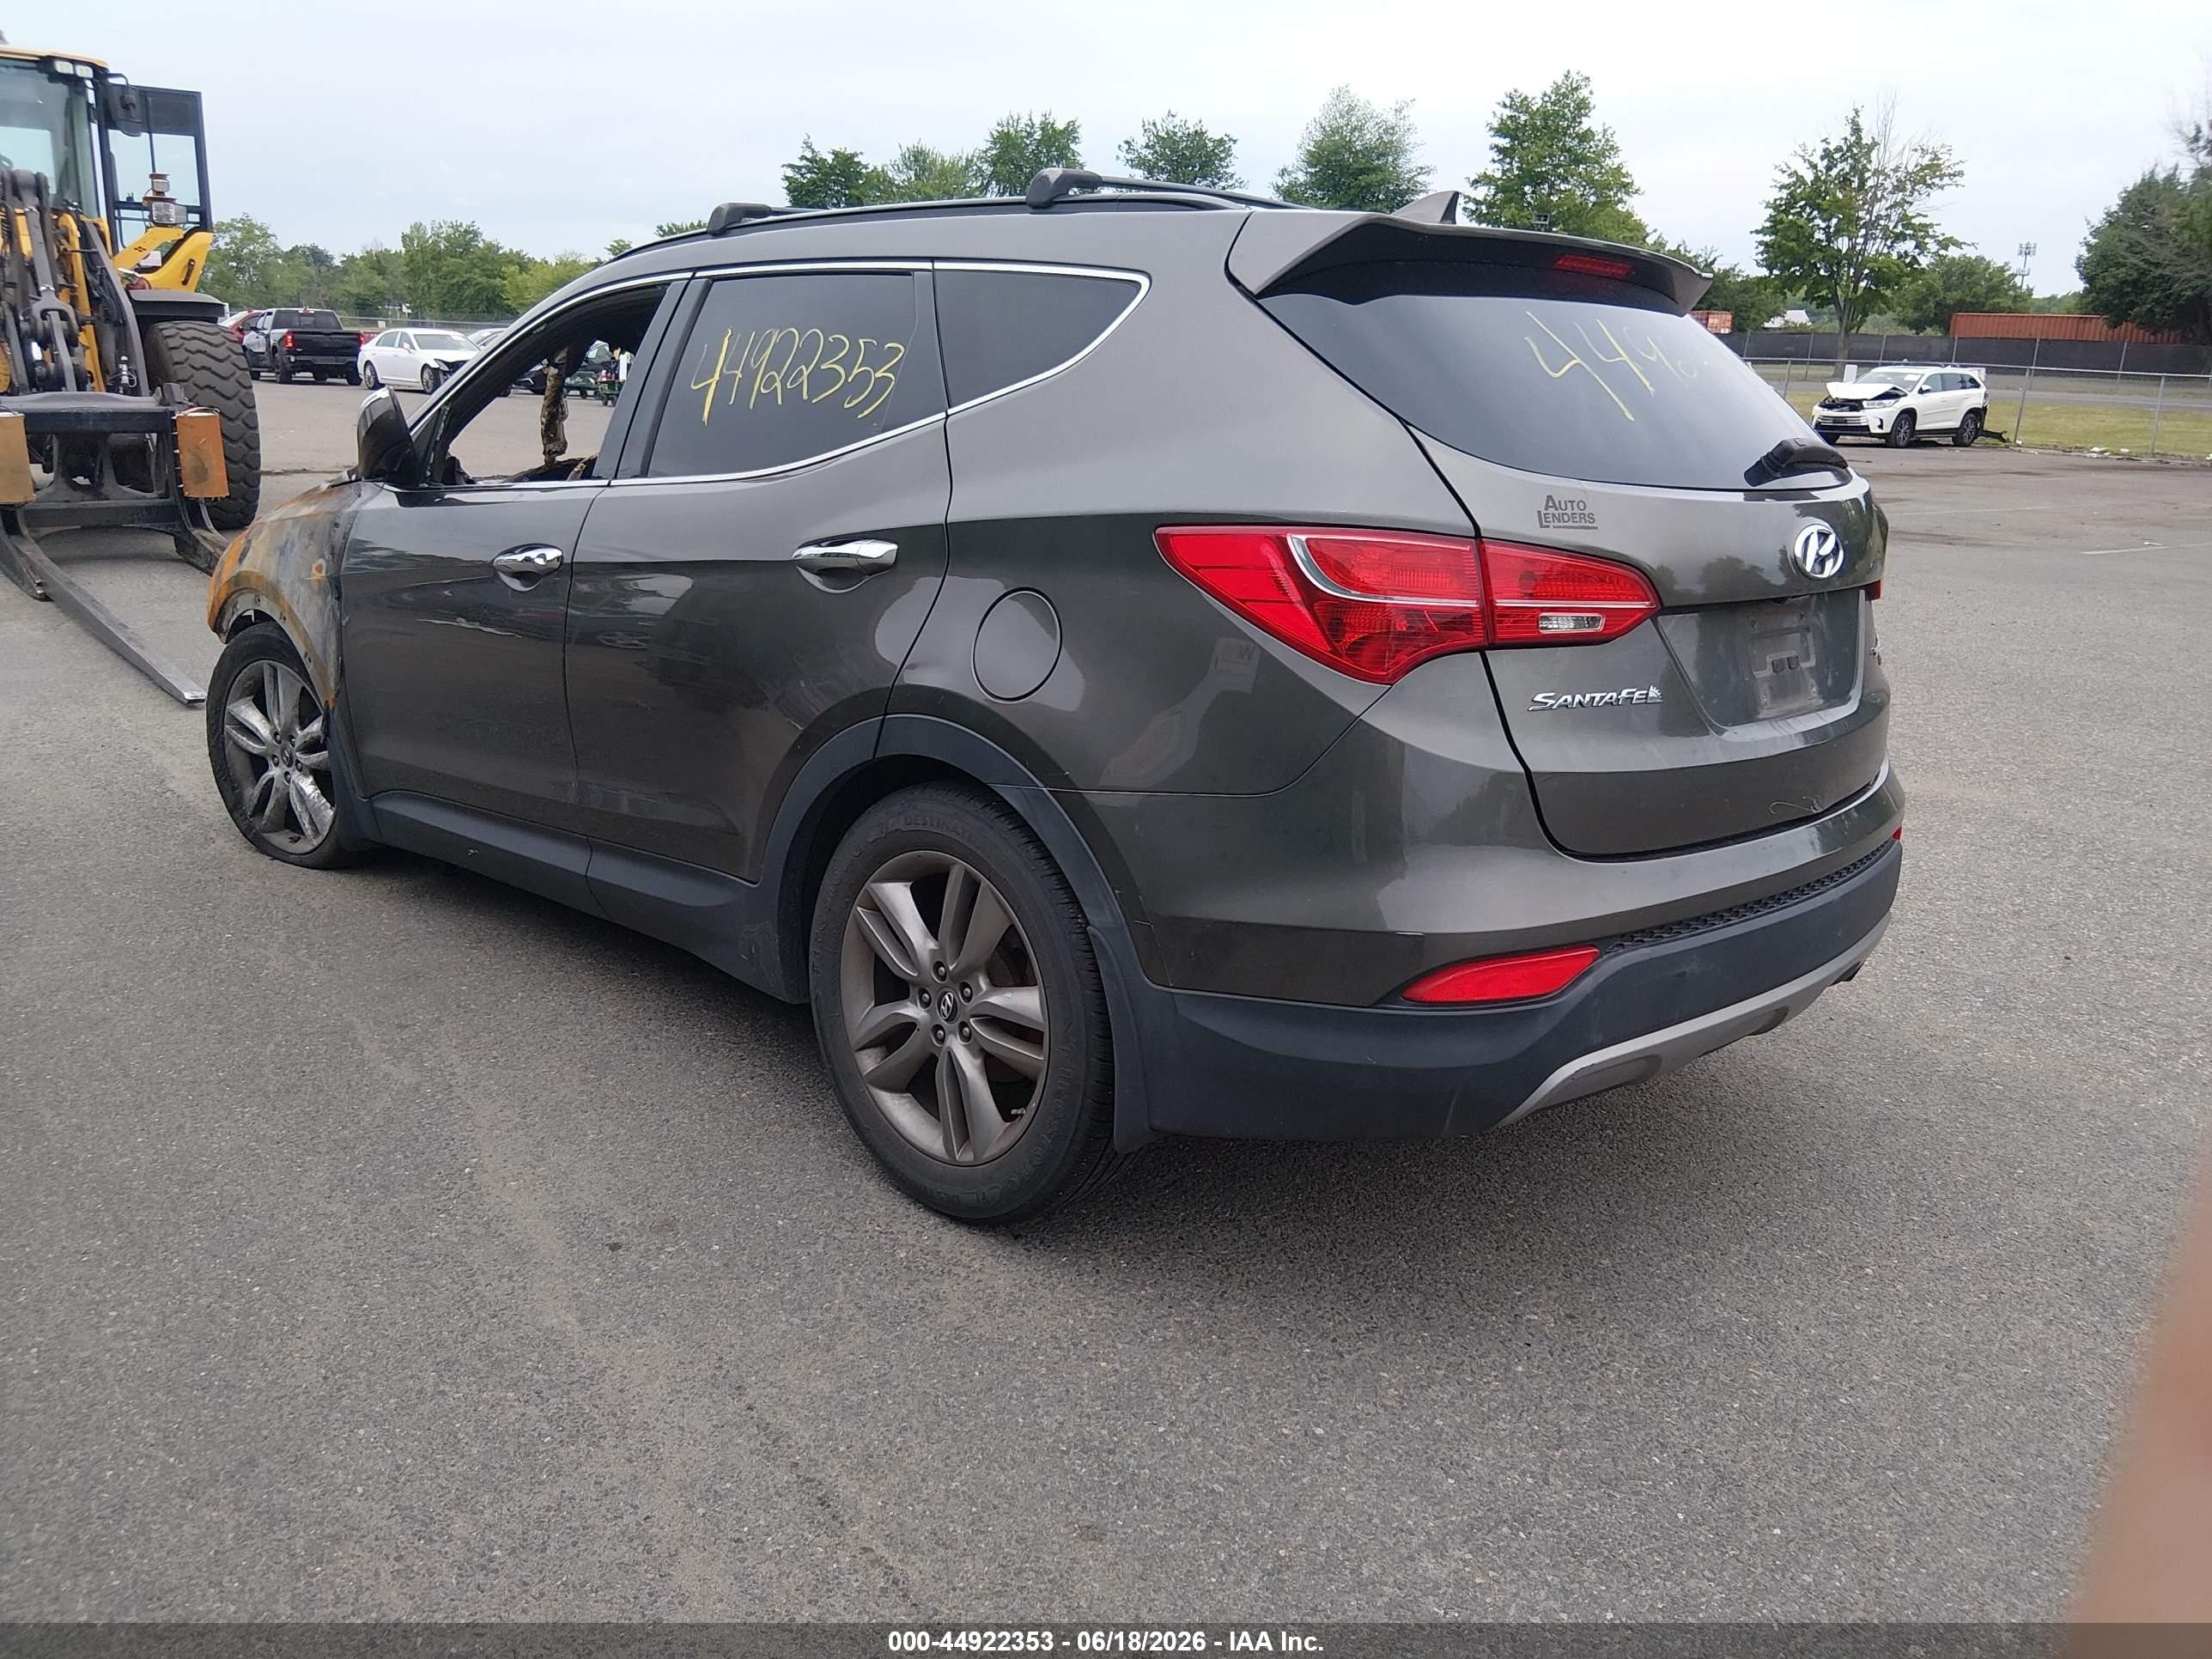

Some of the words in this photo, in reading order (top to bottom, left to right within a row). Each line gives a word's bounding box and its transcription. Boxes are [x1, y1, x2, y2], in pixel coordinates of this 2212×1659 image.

[690, 327, 905, 426] 44922353
[1544, 495, 1587, 511] AUTO
[1537, 510, 1596, 529] LENDERS
